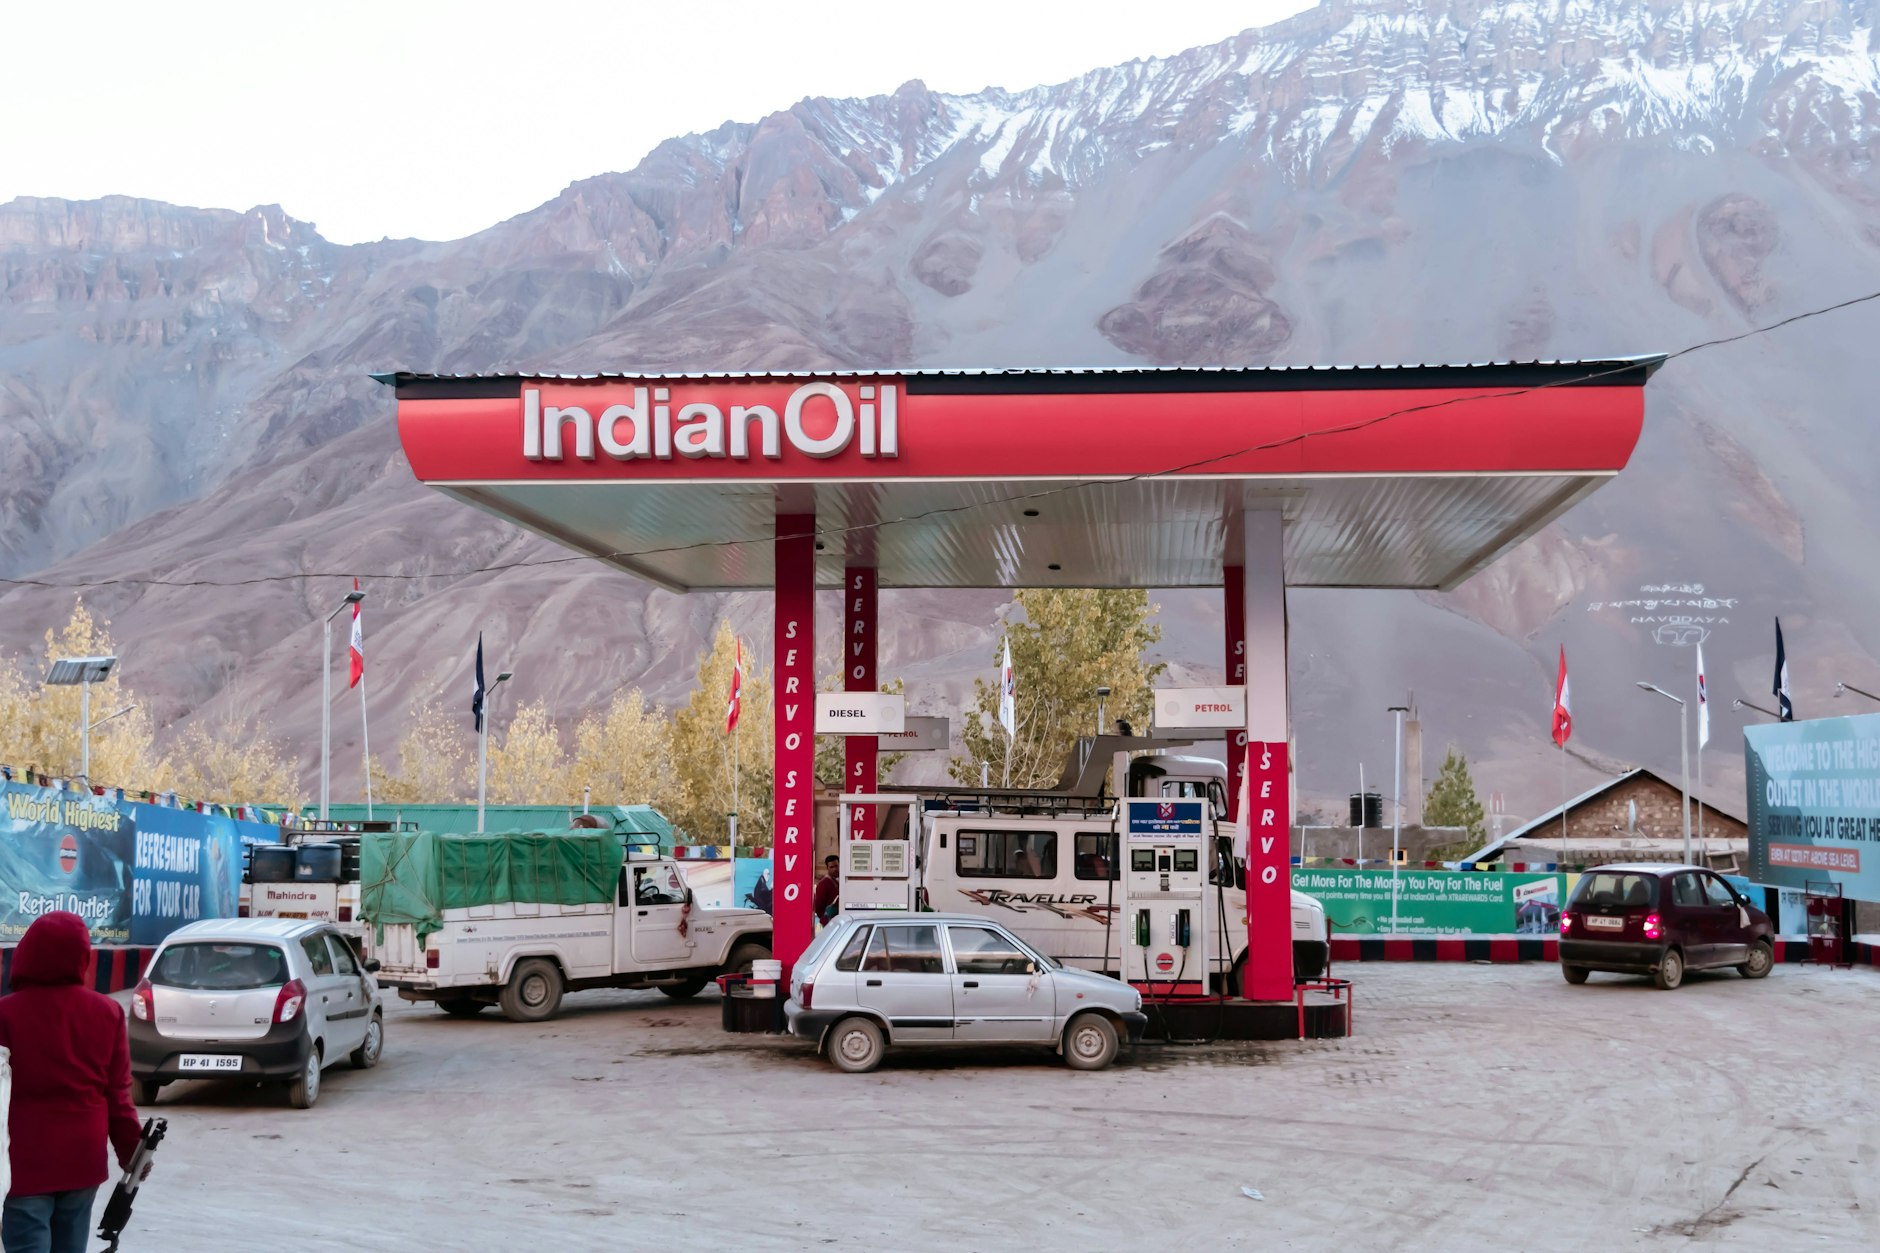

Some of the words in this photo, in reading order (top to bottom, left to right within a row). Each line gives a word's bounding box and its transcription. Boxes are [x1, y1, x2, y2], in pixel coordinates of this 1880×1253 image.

[523, 382, 899, 460] IndianOil
[853, 575, 866, 680] SERVO
[785, 620, 801, 751] SERVO
[829, 709, 867, 718] DIESEL
[1194, 703, 1233, 713] PETROL
[1765, 742, 1815, 772] WELCOME
[1815, 741, 1831, 770] TO
[1832, 740, 1855, 769] THE
[1856, 738, 1880, 769] HIG
[1766, 779, 1803, 807] OUTLET
[1804, 779, 1817, 807] IN
[1818, 779, 1840, 808] THE
[8, 793, 60, 824] World
[65, 800, 120, 832] Highest
[1259, 751, 1277, 884] SERVO
[1804, 815, 1822, 838] YOU
[1824, 816, 1835, 838] AT
[1836, 816, 1867, 841] GREAT
[784, 770, 800, 901] SERVO
[136, 831, 200, 875] REFRESHMENT
[267, 889, 317, 901] Mahindra
[988, 889, 1098, 905] TRAVELLER
[1292, 874, 1309, 887] Get
[1311, 875, 1336, 887] More
[1337, 875, 1353, 888] For
[1354, 875, 1372, 888] The
[1373, 876, 1406, 892] Money
[1408, 876, 1425, 890] You
[1427, 877, 1445, 893] Pay
[1447, 877, 1462, 890] For
[1464, 877, 1482, 891] The
[1483, 877, 1503, 891] Fuel
[19, 891, 64, 915] Retail
[68, 894, 111, 918] Outlet
[132, 879, 152, 916] FOR
[156, 880, 181, 917] YOUR
[183, 883, 200, 920] CAR
[183, 1059, 196, 1067] HP
[200, 1059, 210, 1067] 41
[216, 1059, 238, 1067] 1595
